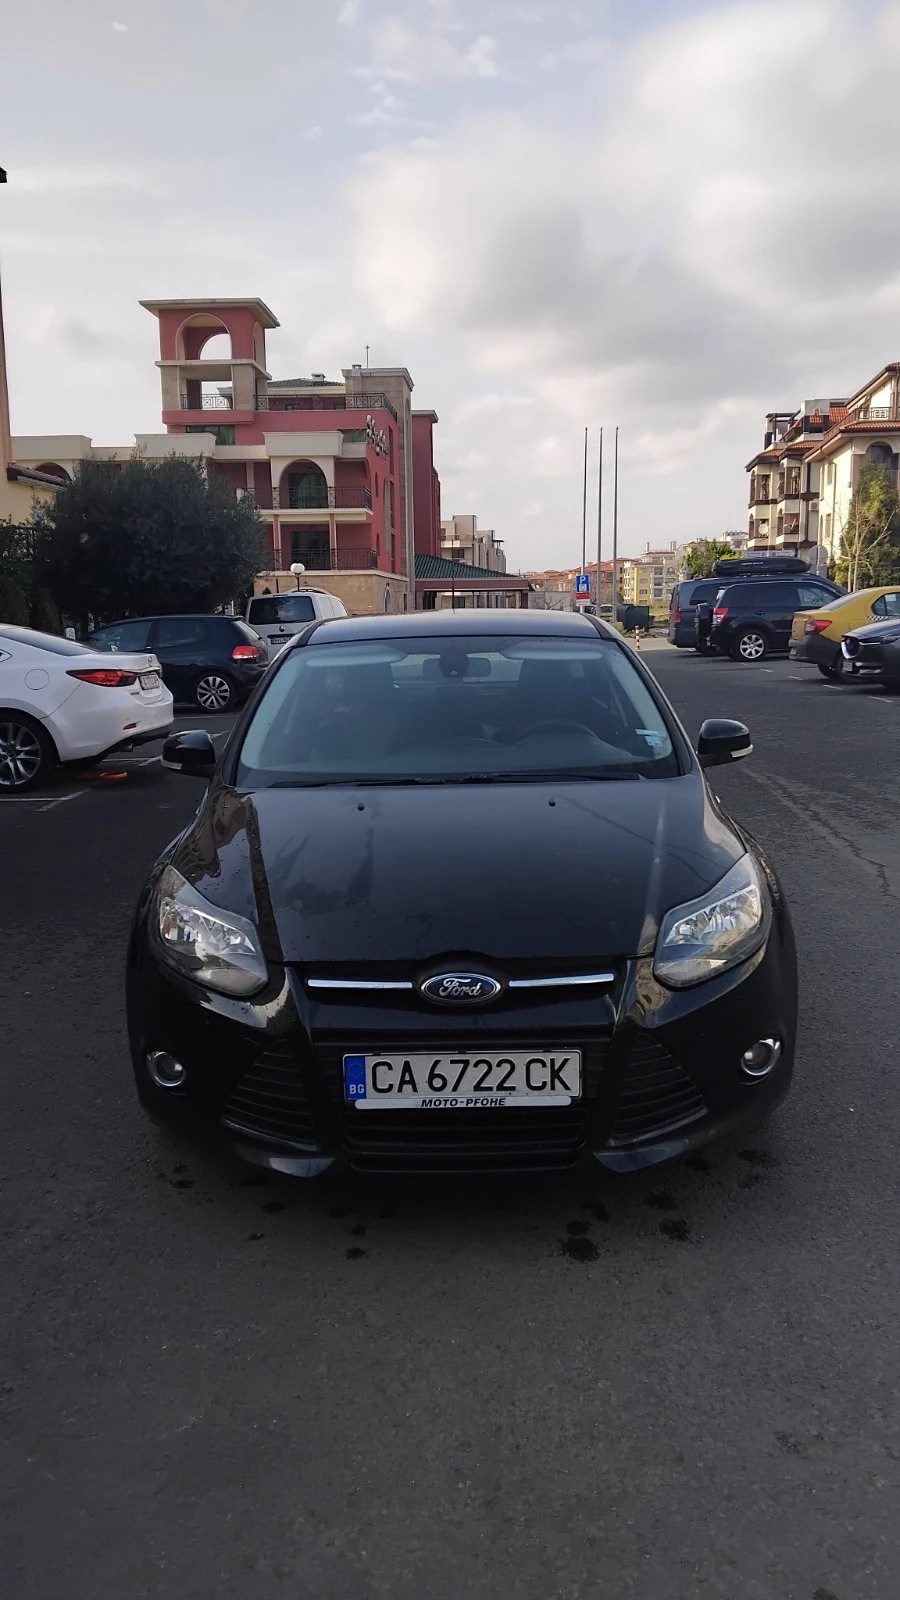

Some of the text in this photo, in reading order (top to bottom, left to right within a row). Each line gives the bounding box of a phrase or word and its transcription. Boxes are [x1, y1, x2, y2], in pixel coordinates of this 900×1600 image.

[580, 575, 586, 584] P
[439, 978, 482, 997] Ford
[371, 1057, 571, 1094] CA 6722 CK
[349, 1084, 365, 1095] BG
[421, 1097, 506, 1109] MOTO-PFOHE
